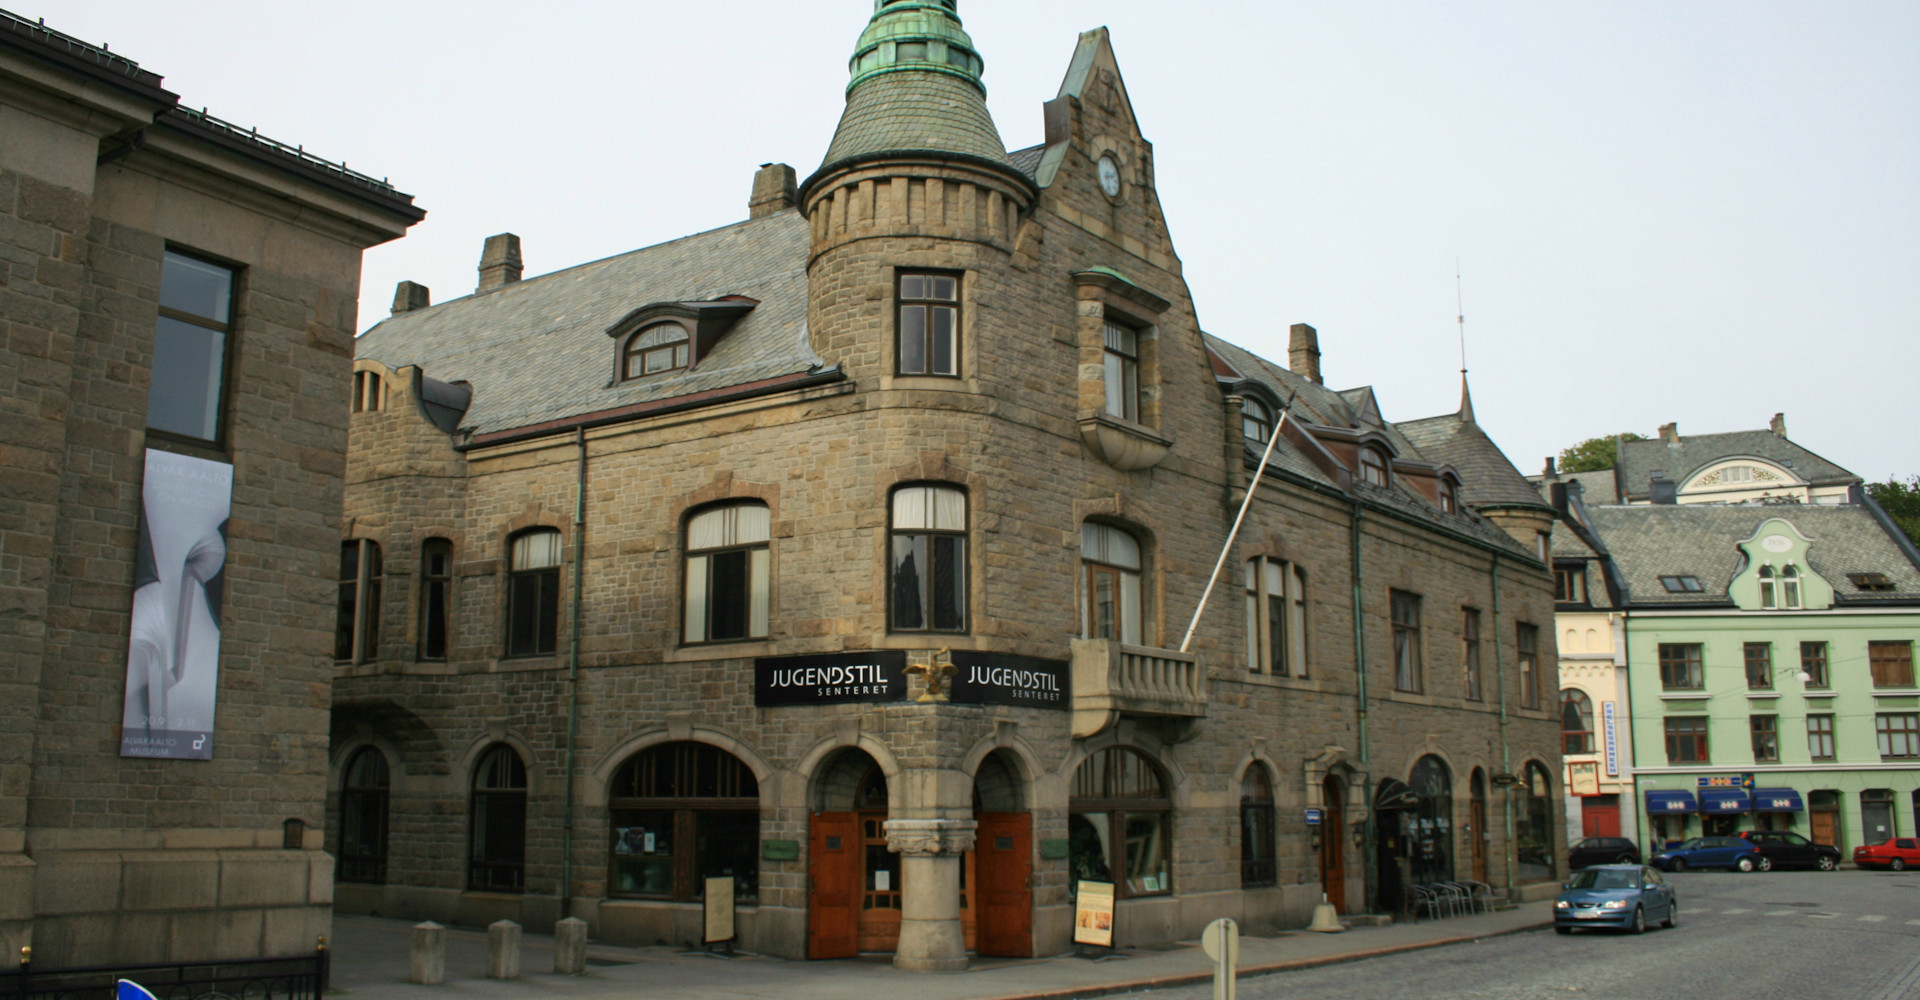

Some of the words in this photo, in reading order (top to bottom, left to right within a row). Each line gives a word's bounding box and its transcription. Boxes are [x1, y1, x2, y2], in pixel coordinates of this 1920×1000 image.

[189, 468, 230, 485] AALTO
[770, 665, 888, 688] JUGENDSTIL
[967, 665, 1061, 692] JUGENDSTIL
[817, 685, 888, 697] SENTERET
[1012, 689, 1061, 702] SENTERET
[1605, 703, 1617, 773] FRELSESARMEEN
[129, 747, 170, 756] MUSEUM
